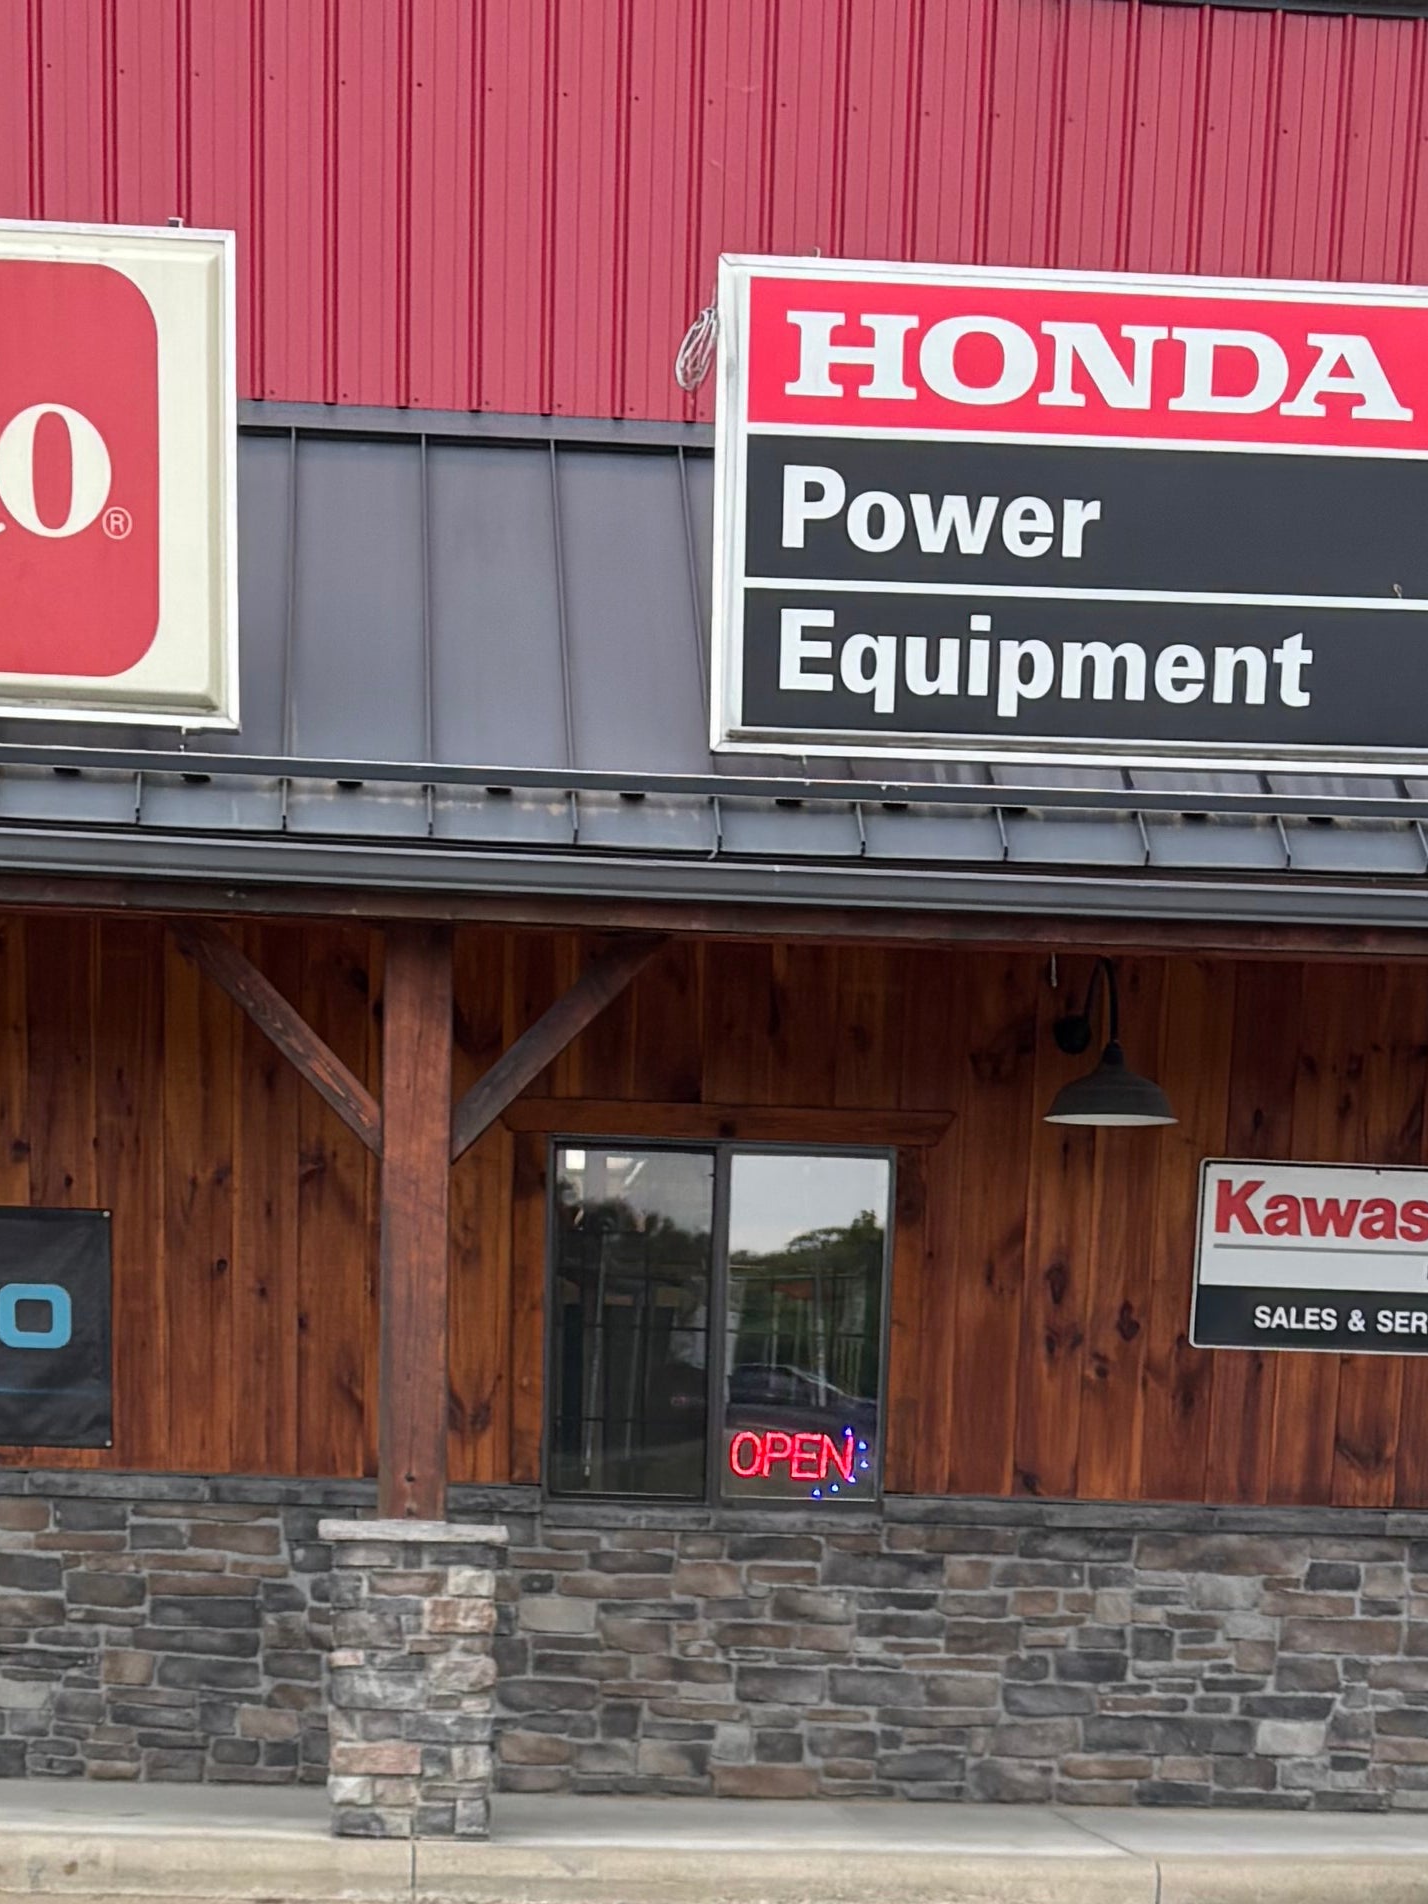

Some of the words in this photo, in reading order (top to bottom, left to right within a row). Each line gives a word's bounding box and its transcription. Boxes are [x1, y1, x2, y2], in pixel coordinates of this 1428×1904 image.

[783, 309, 1415, 422] HONDA
[780, 463, 1101, 559] Power
[777, 607, 1315, 718] Equipment
[1253, 1305, 1338, 1331] SALES
[1347, 1310, 1367, 1332] &
[729, 1430, 856, 1481] OPEN
